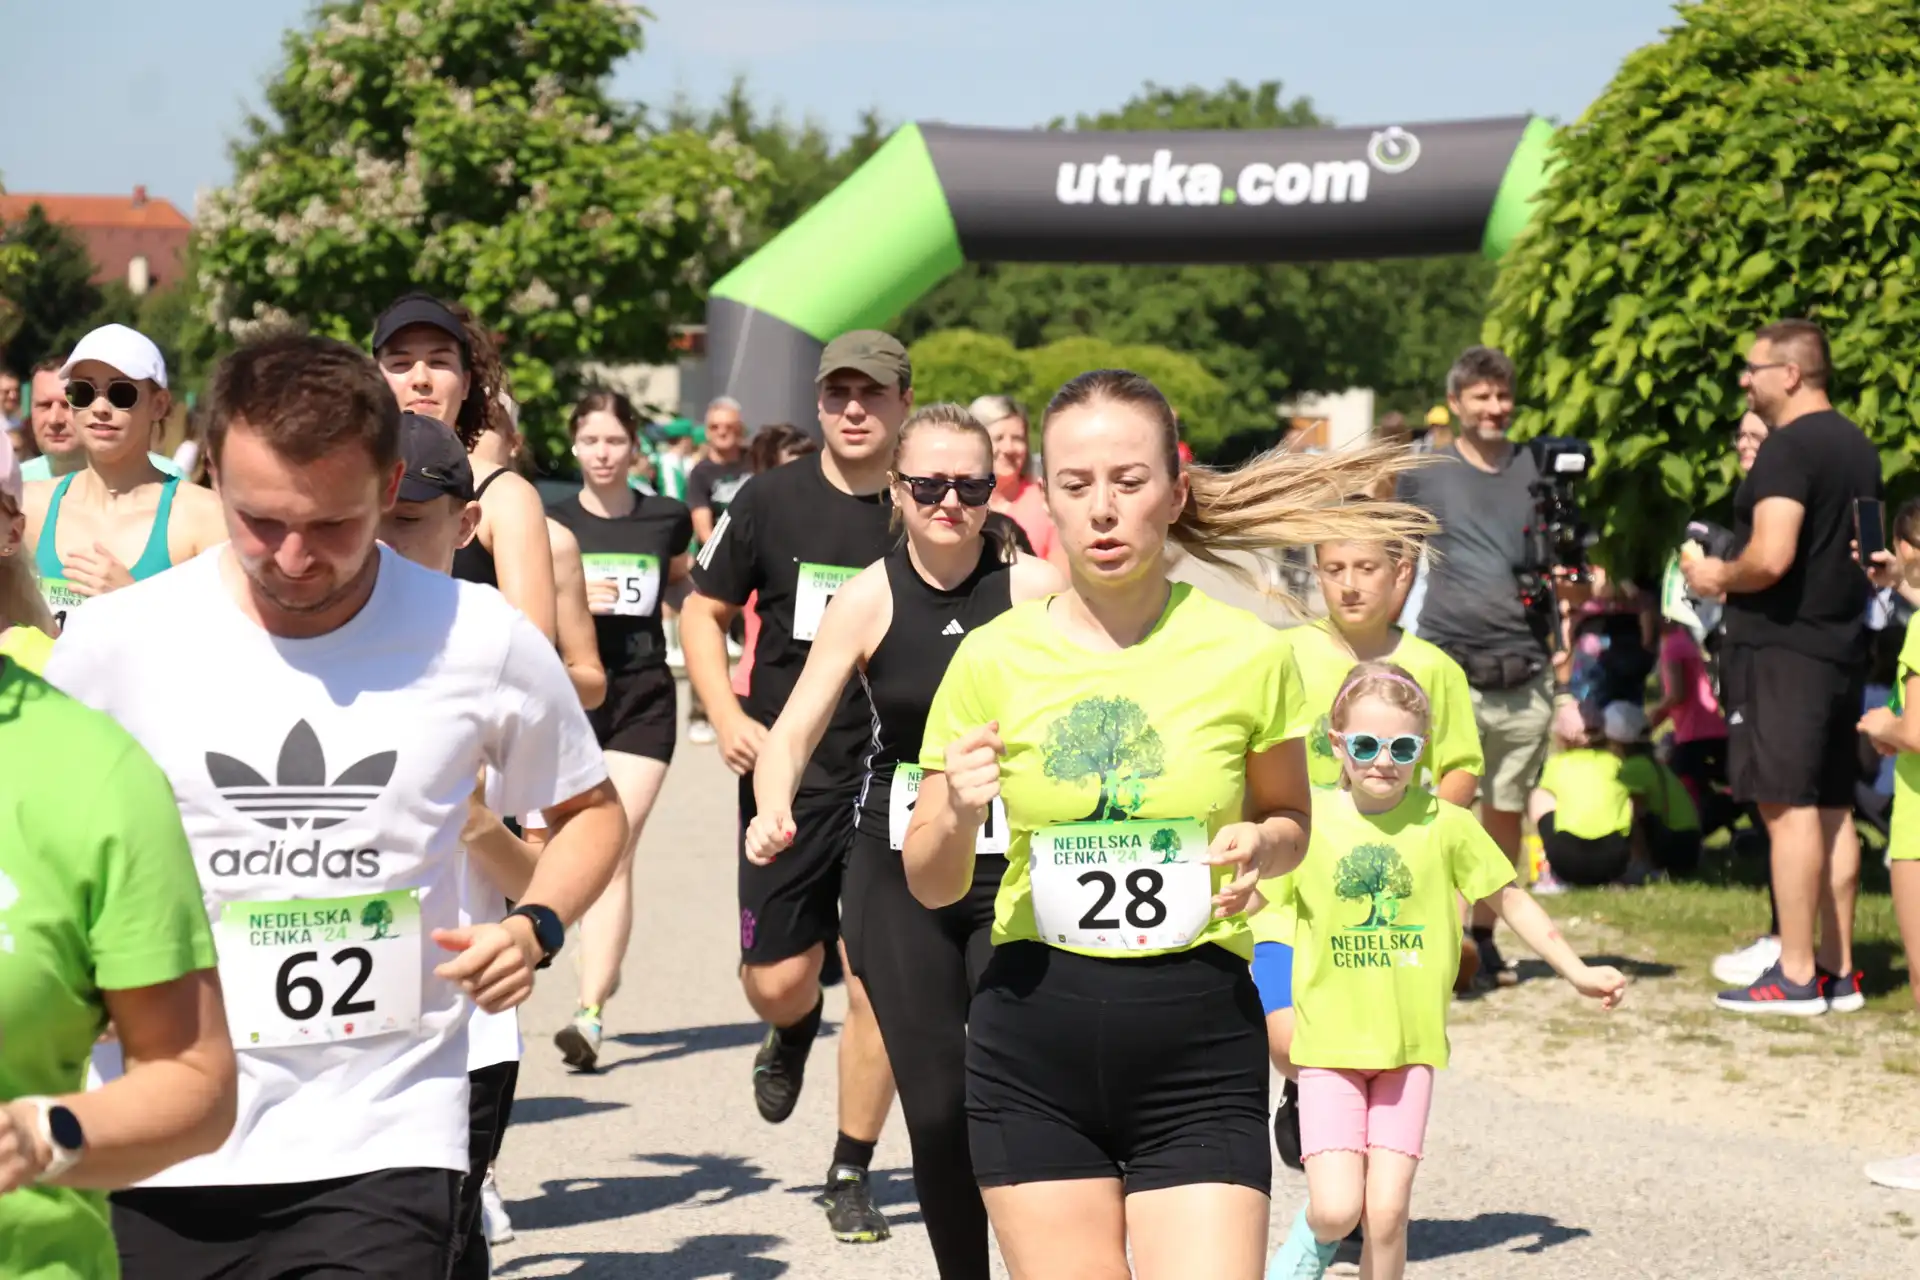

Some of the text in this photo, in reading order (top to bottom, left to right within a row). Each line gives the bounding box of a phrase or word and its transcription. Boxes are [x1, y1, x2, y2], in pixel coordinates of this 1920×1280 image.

[1056, 149, 1370, 205] utrka.com
[605, 576, 642, 604] 5
[1054, 834, 1143, 851] NEDELSKA
[209, 839, 381, 879] adidas
[1054, 850, 1108, 866] CENKA
[1076, 868, 1167, 930] 28
[250, 908, 352, 930] NEDELSKA
[250, 929, 312, 947] CENKA
[1331, 933, 1424, 951] NEDELSKA
[1333, 951, 1392, 969] CENKA
[275, 946, 376, 1021] 62
